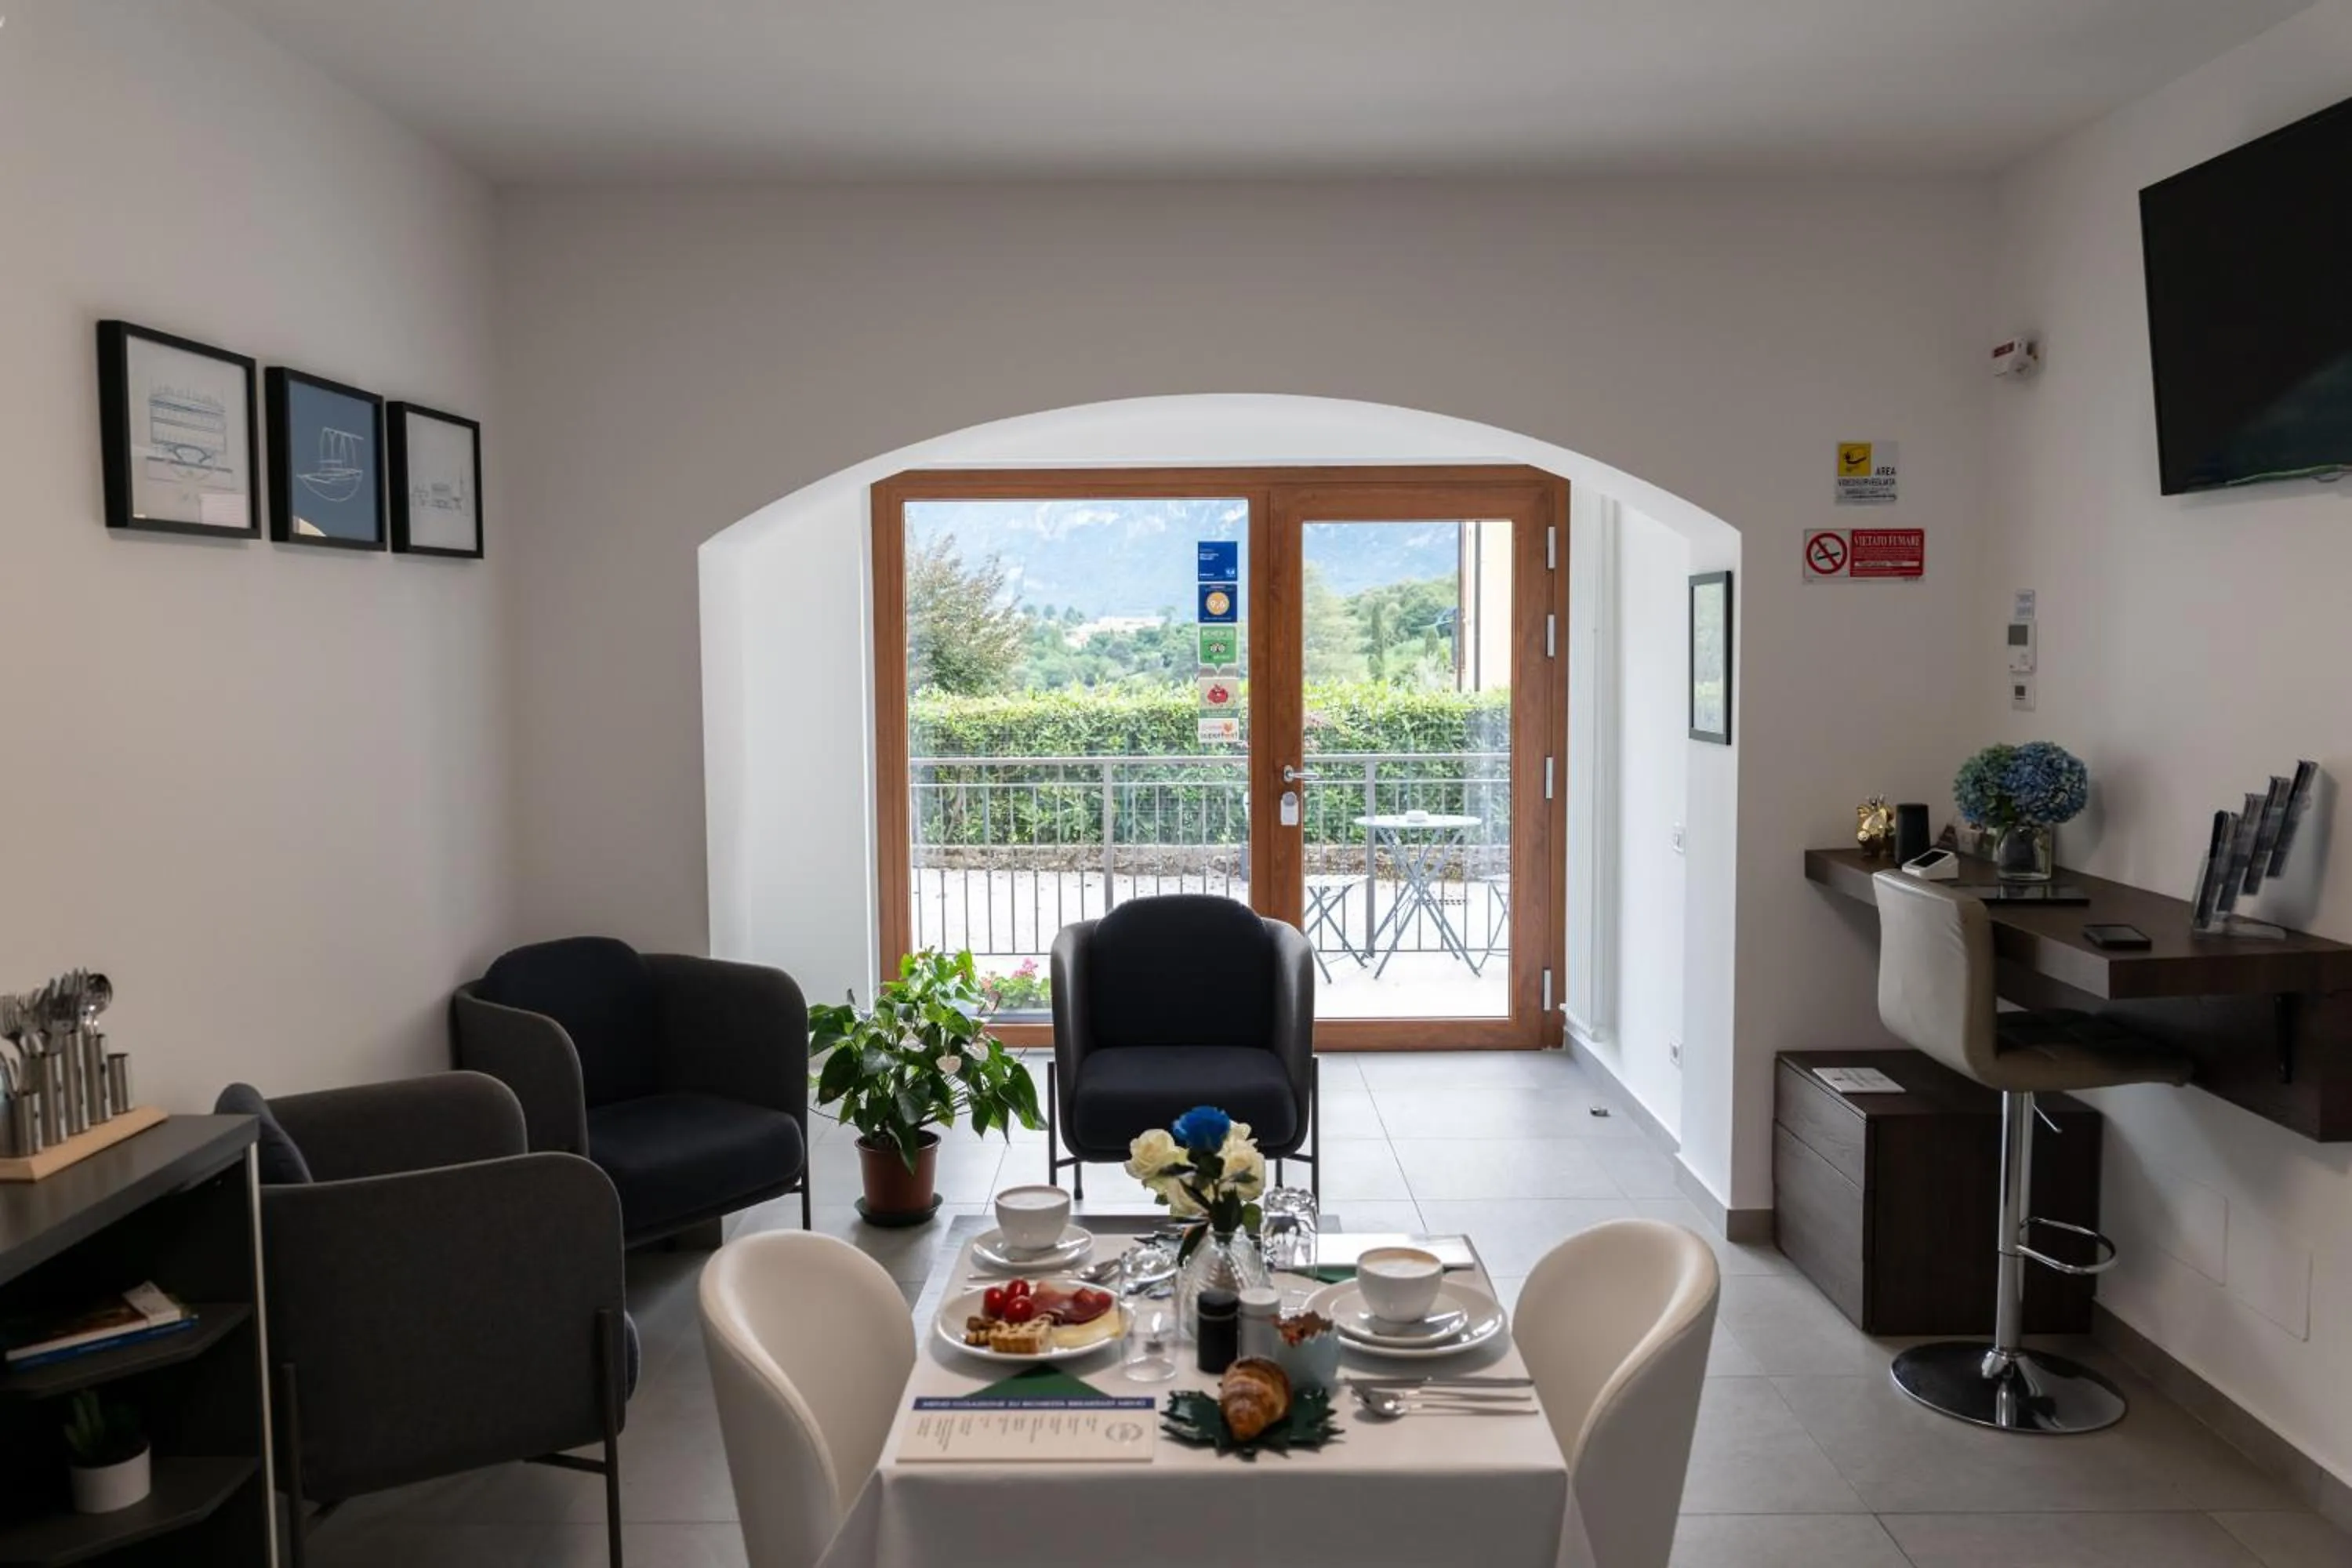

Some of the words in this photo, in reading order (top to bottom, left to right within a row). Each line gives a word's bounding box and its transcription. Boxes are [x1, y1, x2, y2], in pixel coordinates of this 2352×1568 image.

[1875, 466, 1896, 476] AREA
[1854, 535, 1887, 546] VIETATO
[1889, 535, 1920, 546] FUMARE
